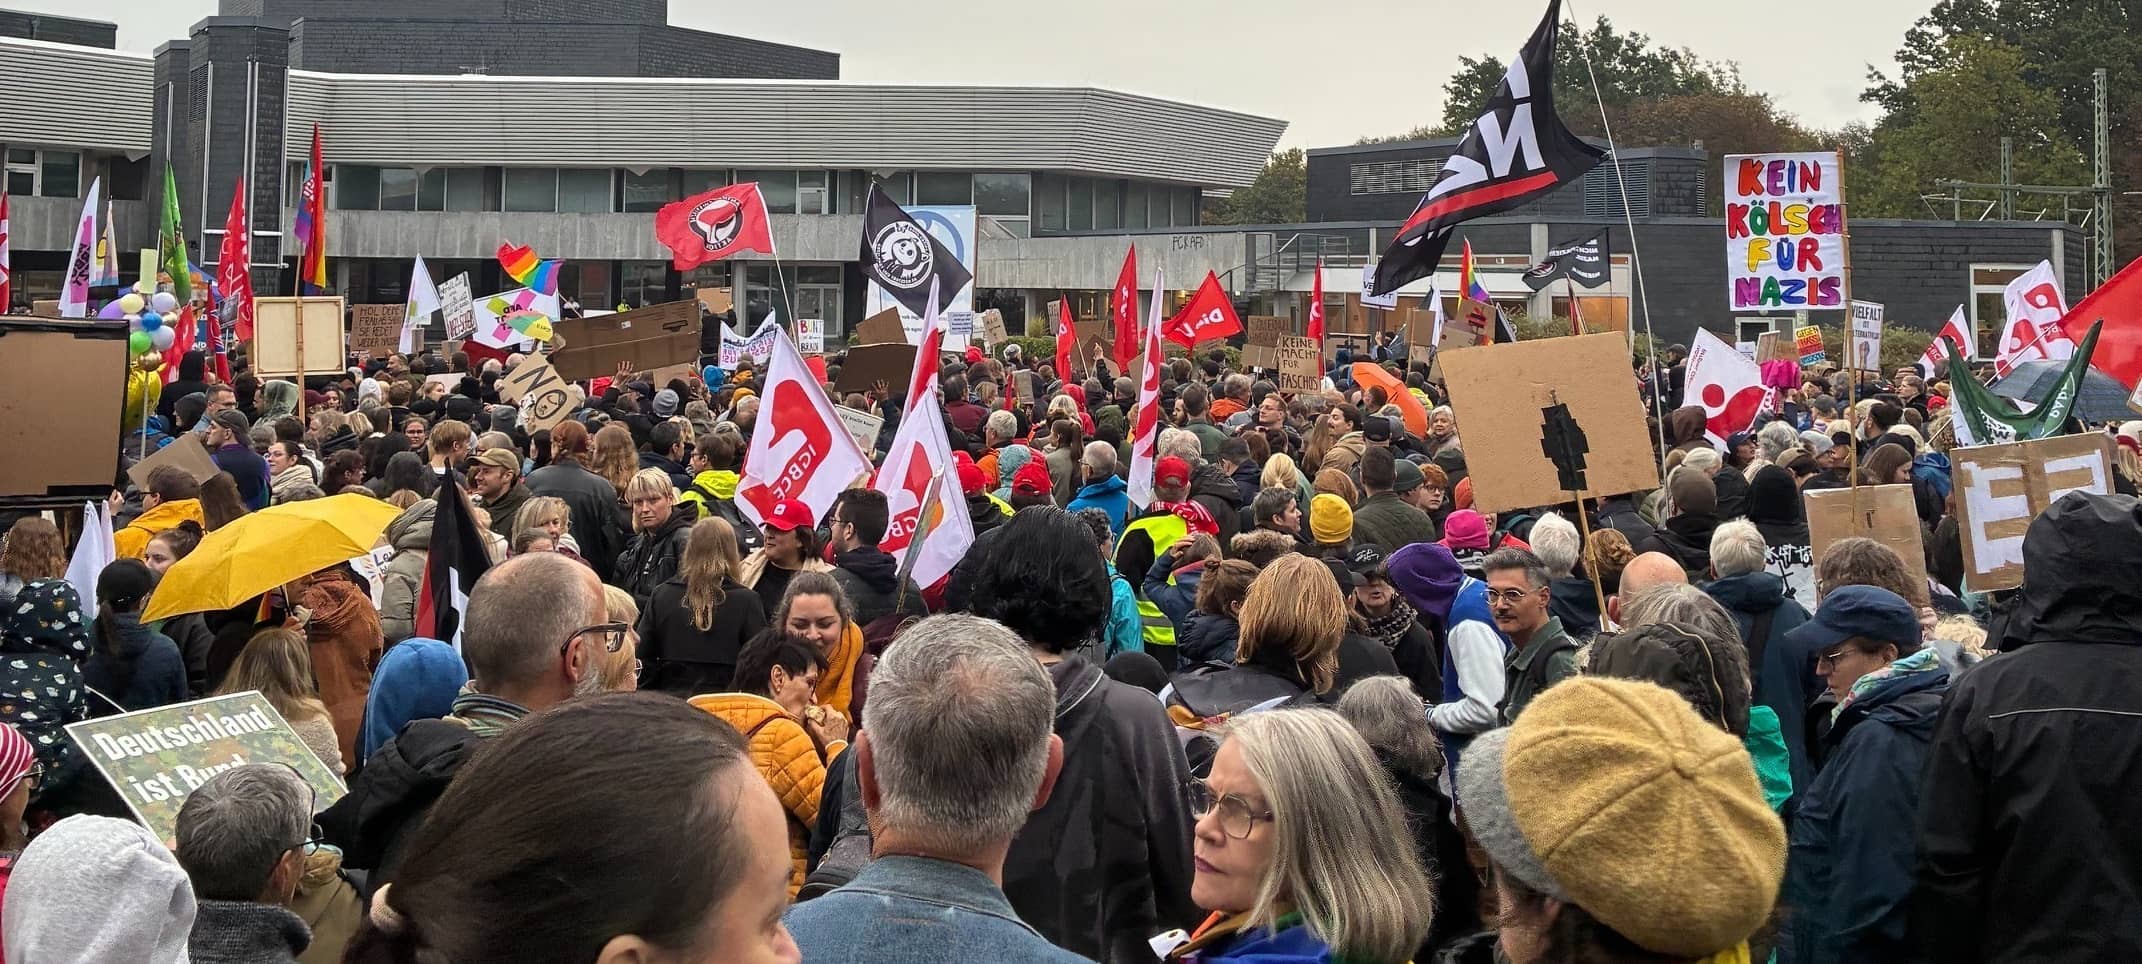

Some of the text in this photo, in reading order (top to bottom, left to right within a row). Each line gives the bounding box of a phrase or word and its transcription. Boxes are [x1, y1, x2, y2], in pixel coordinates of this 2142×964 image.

[1737, 158, 1822, 197] KEIN
[1727, 199, 1843, 239] KÖLSCH
[1747, 237, 1823, 272] FÜR
[1734, 276, 1841, 307] NAZIS
[1281, 349, 1316, 359] MACHT
[1282, 337, 1313, 348] KEINE
[1280, 373, 1318, 391] FASCHOS
[91, 703, 275, 761] Deutschland
[127, 771, 184, 803] ist
